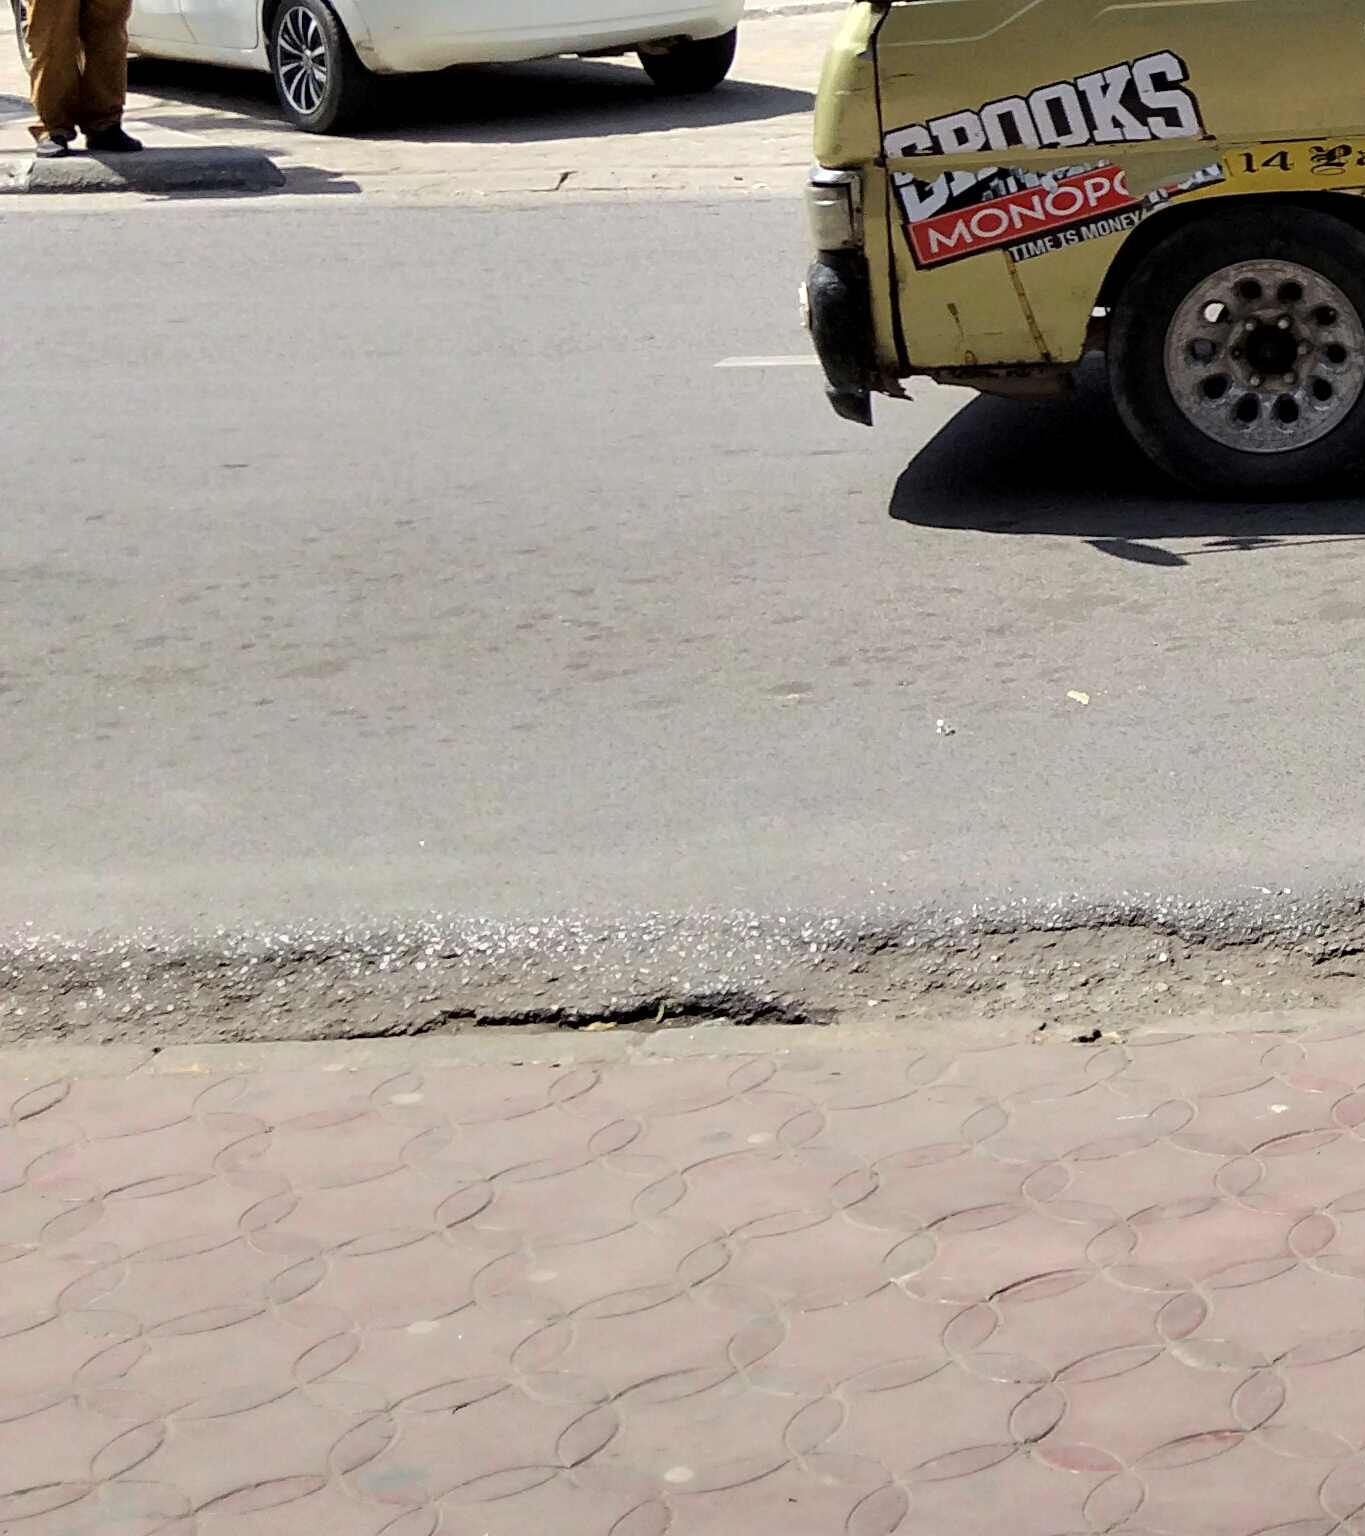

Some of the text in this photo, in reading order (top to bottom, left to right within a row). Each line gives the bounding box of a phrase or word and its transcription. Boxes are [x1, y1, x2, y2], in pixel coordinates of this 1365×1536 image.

[1240, 150, 1295, 173] 14
[1008, 209, 1144, 263] TIME IS MONEY
